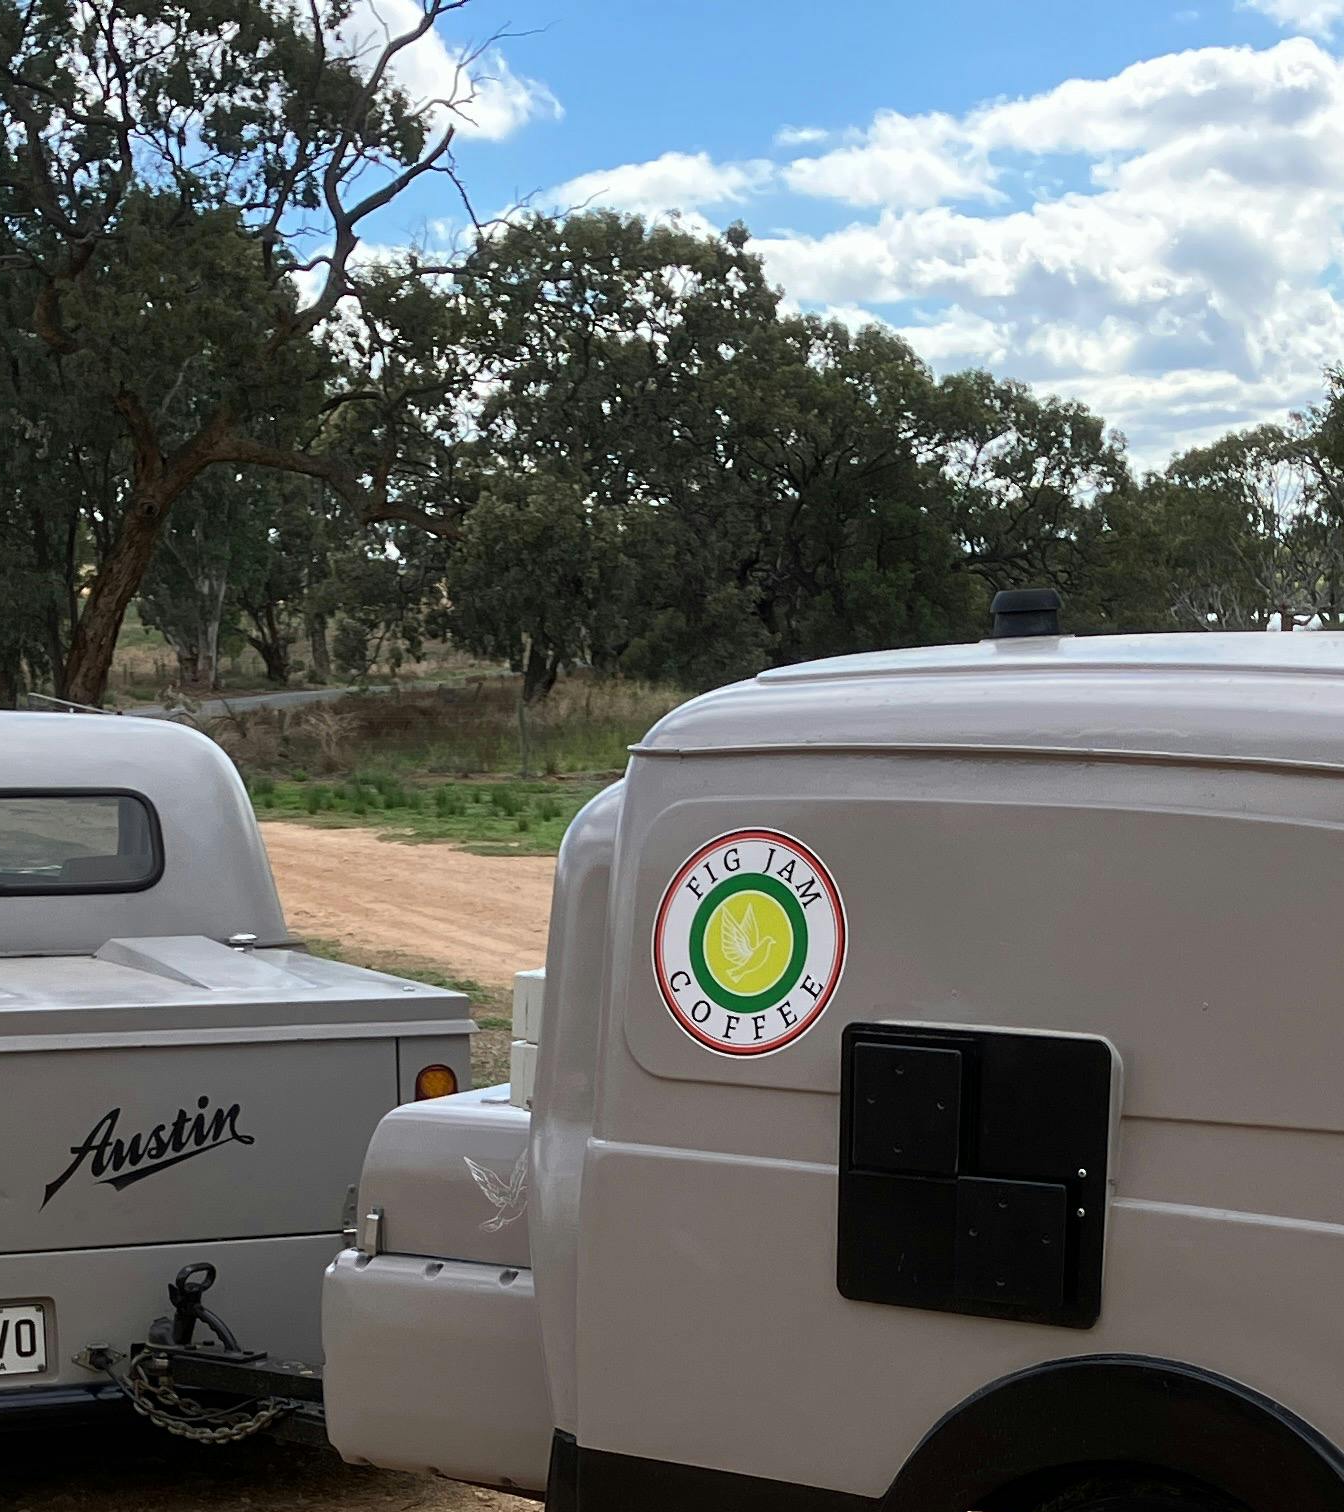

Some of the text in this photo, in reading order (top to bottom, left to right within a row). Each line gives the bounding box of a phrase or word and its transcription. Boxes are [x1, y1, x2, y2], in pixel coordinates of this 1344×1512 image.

[685, 848, 822, 909] FIG JAM
[670, 970, 824, 1041] COFFEE
[38, 1095, 255, 1213] Austin
